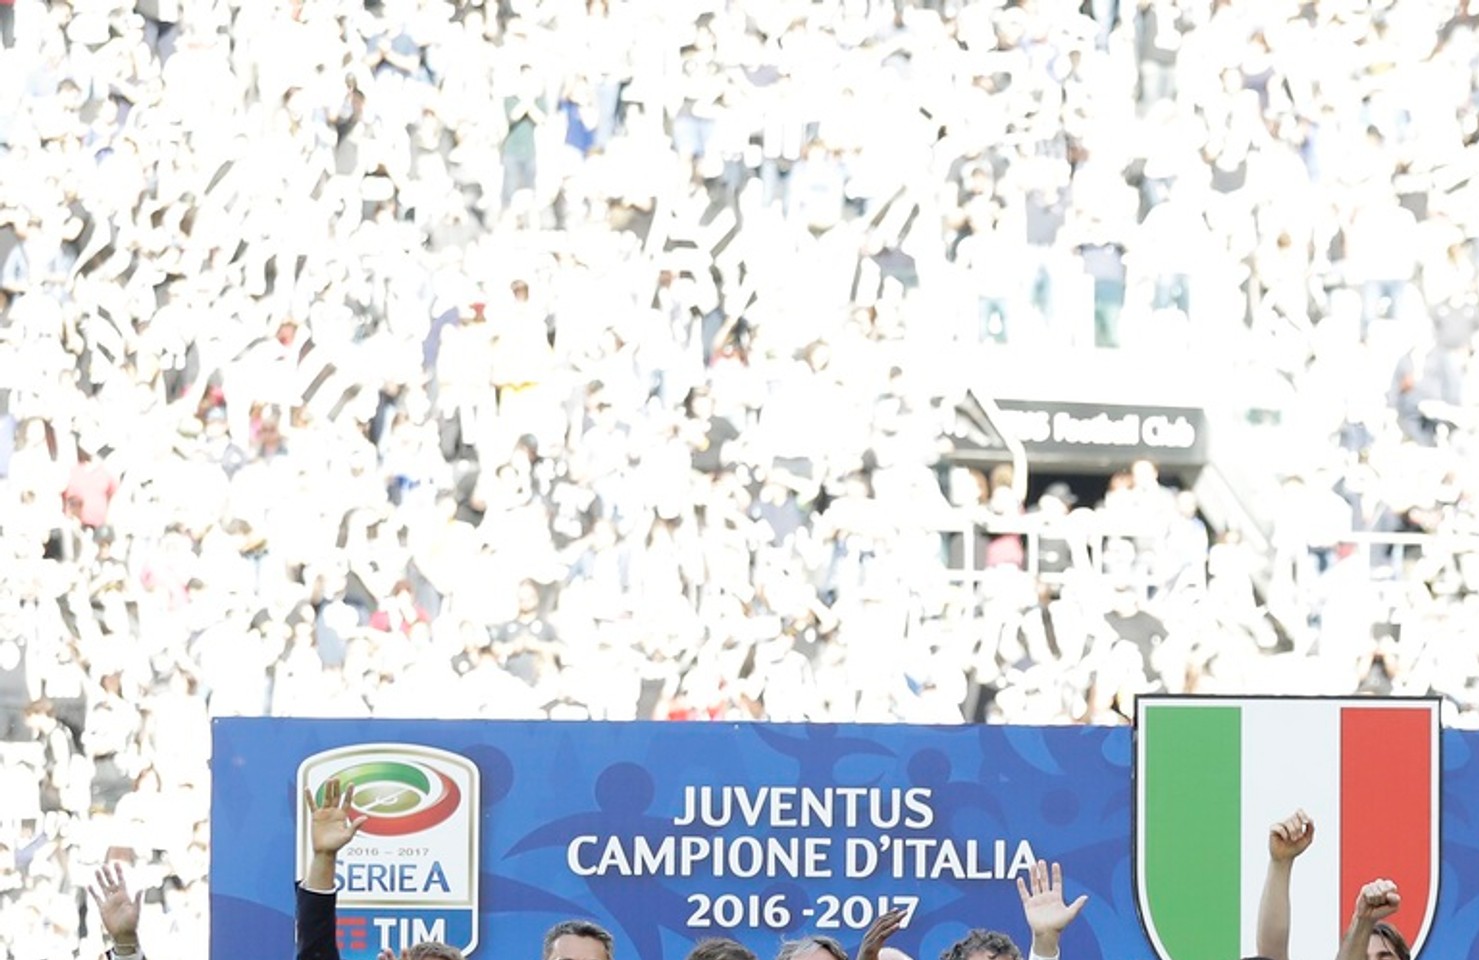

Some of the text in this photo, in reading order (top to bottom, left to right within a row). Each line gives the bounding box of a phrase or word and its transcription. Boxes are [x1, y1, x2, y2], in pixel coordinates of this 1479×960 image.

[673, 785, 934, 829] JUVENTUS
[348, 848, 430, 857] 2016 2017
[566, 834, 1041, 880] CAMPIONE D'ITALIA
[334, 860, 451, 893] SERIE A
[686, 892, 791, 929] 2016
[373, 918, 446, 951] TIM
